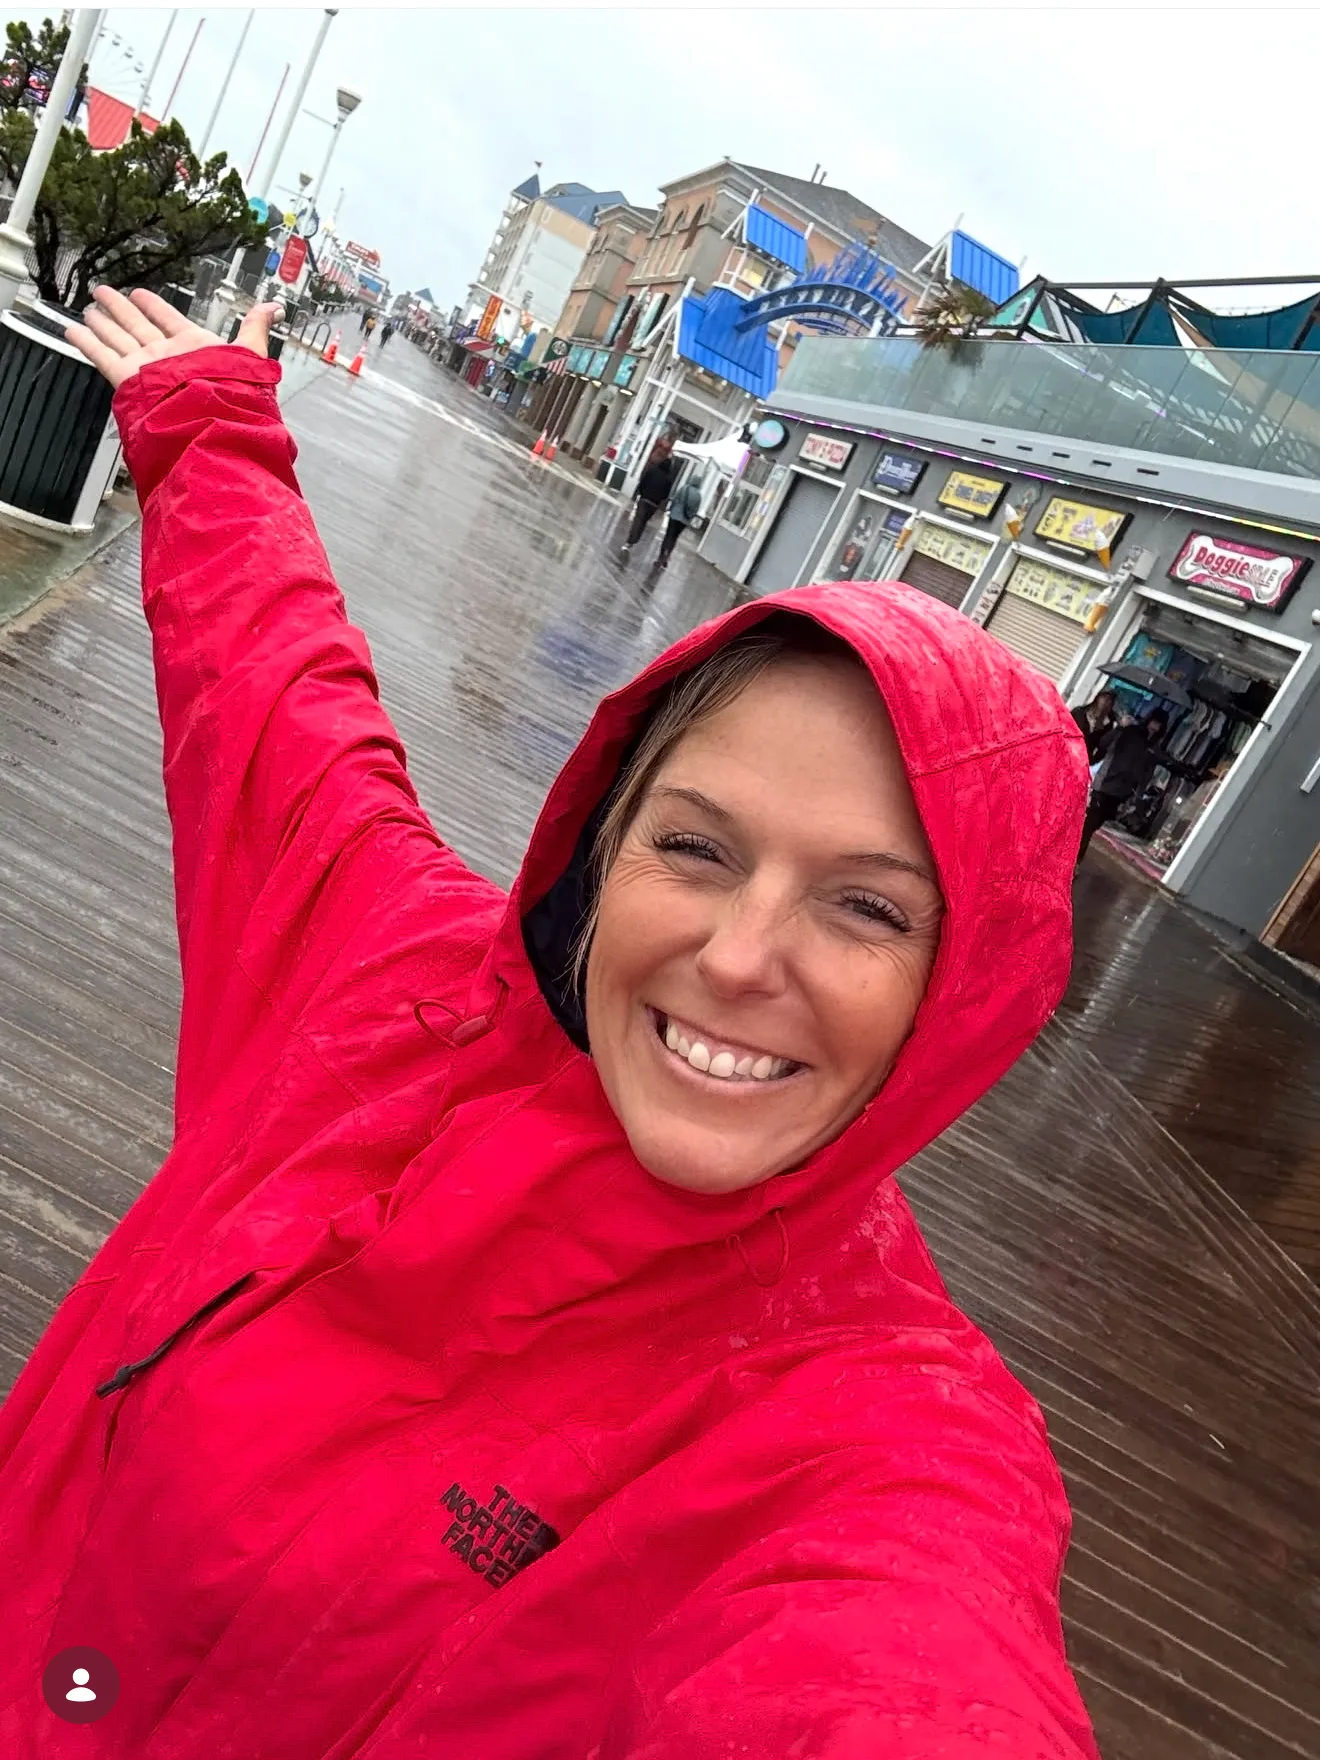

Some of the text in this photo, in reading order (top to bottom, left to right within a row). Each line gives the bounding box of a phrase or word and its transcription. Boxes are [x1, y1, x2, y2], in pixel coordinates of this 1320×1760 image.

[1193, 546, 1250, 577] Doggie
[440, 1482, 527, 1563] NORTH
[488, 1484, 540, 1540] THE
[441, 1521, 512, 1589] FACE
